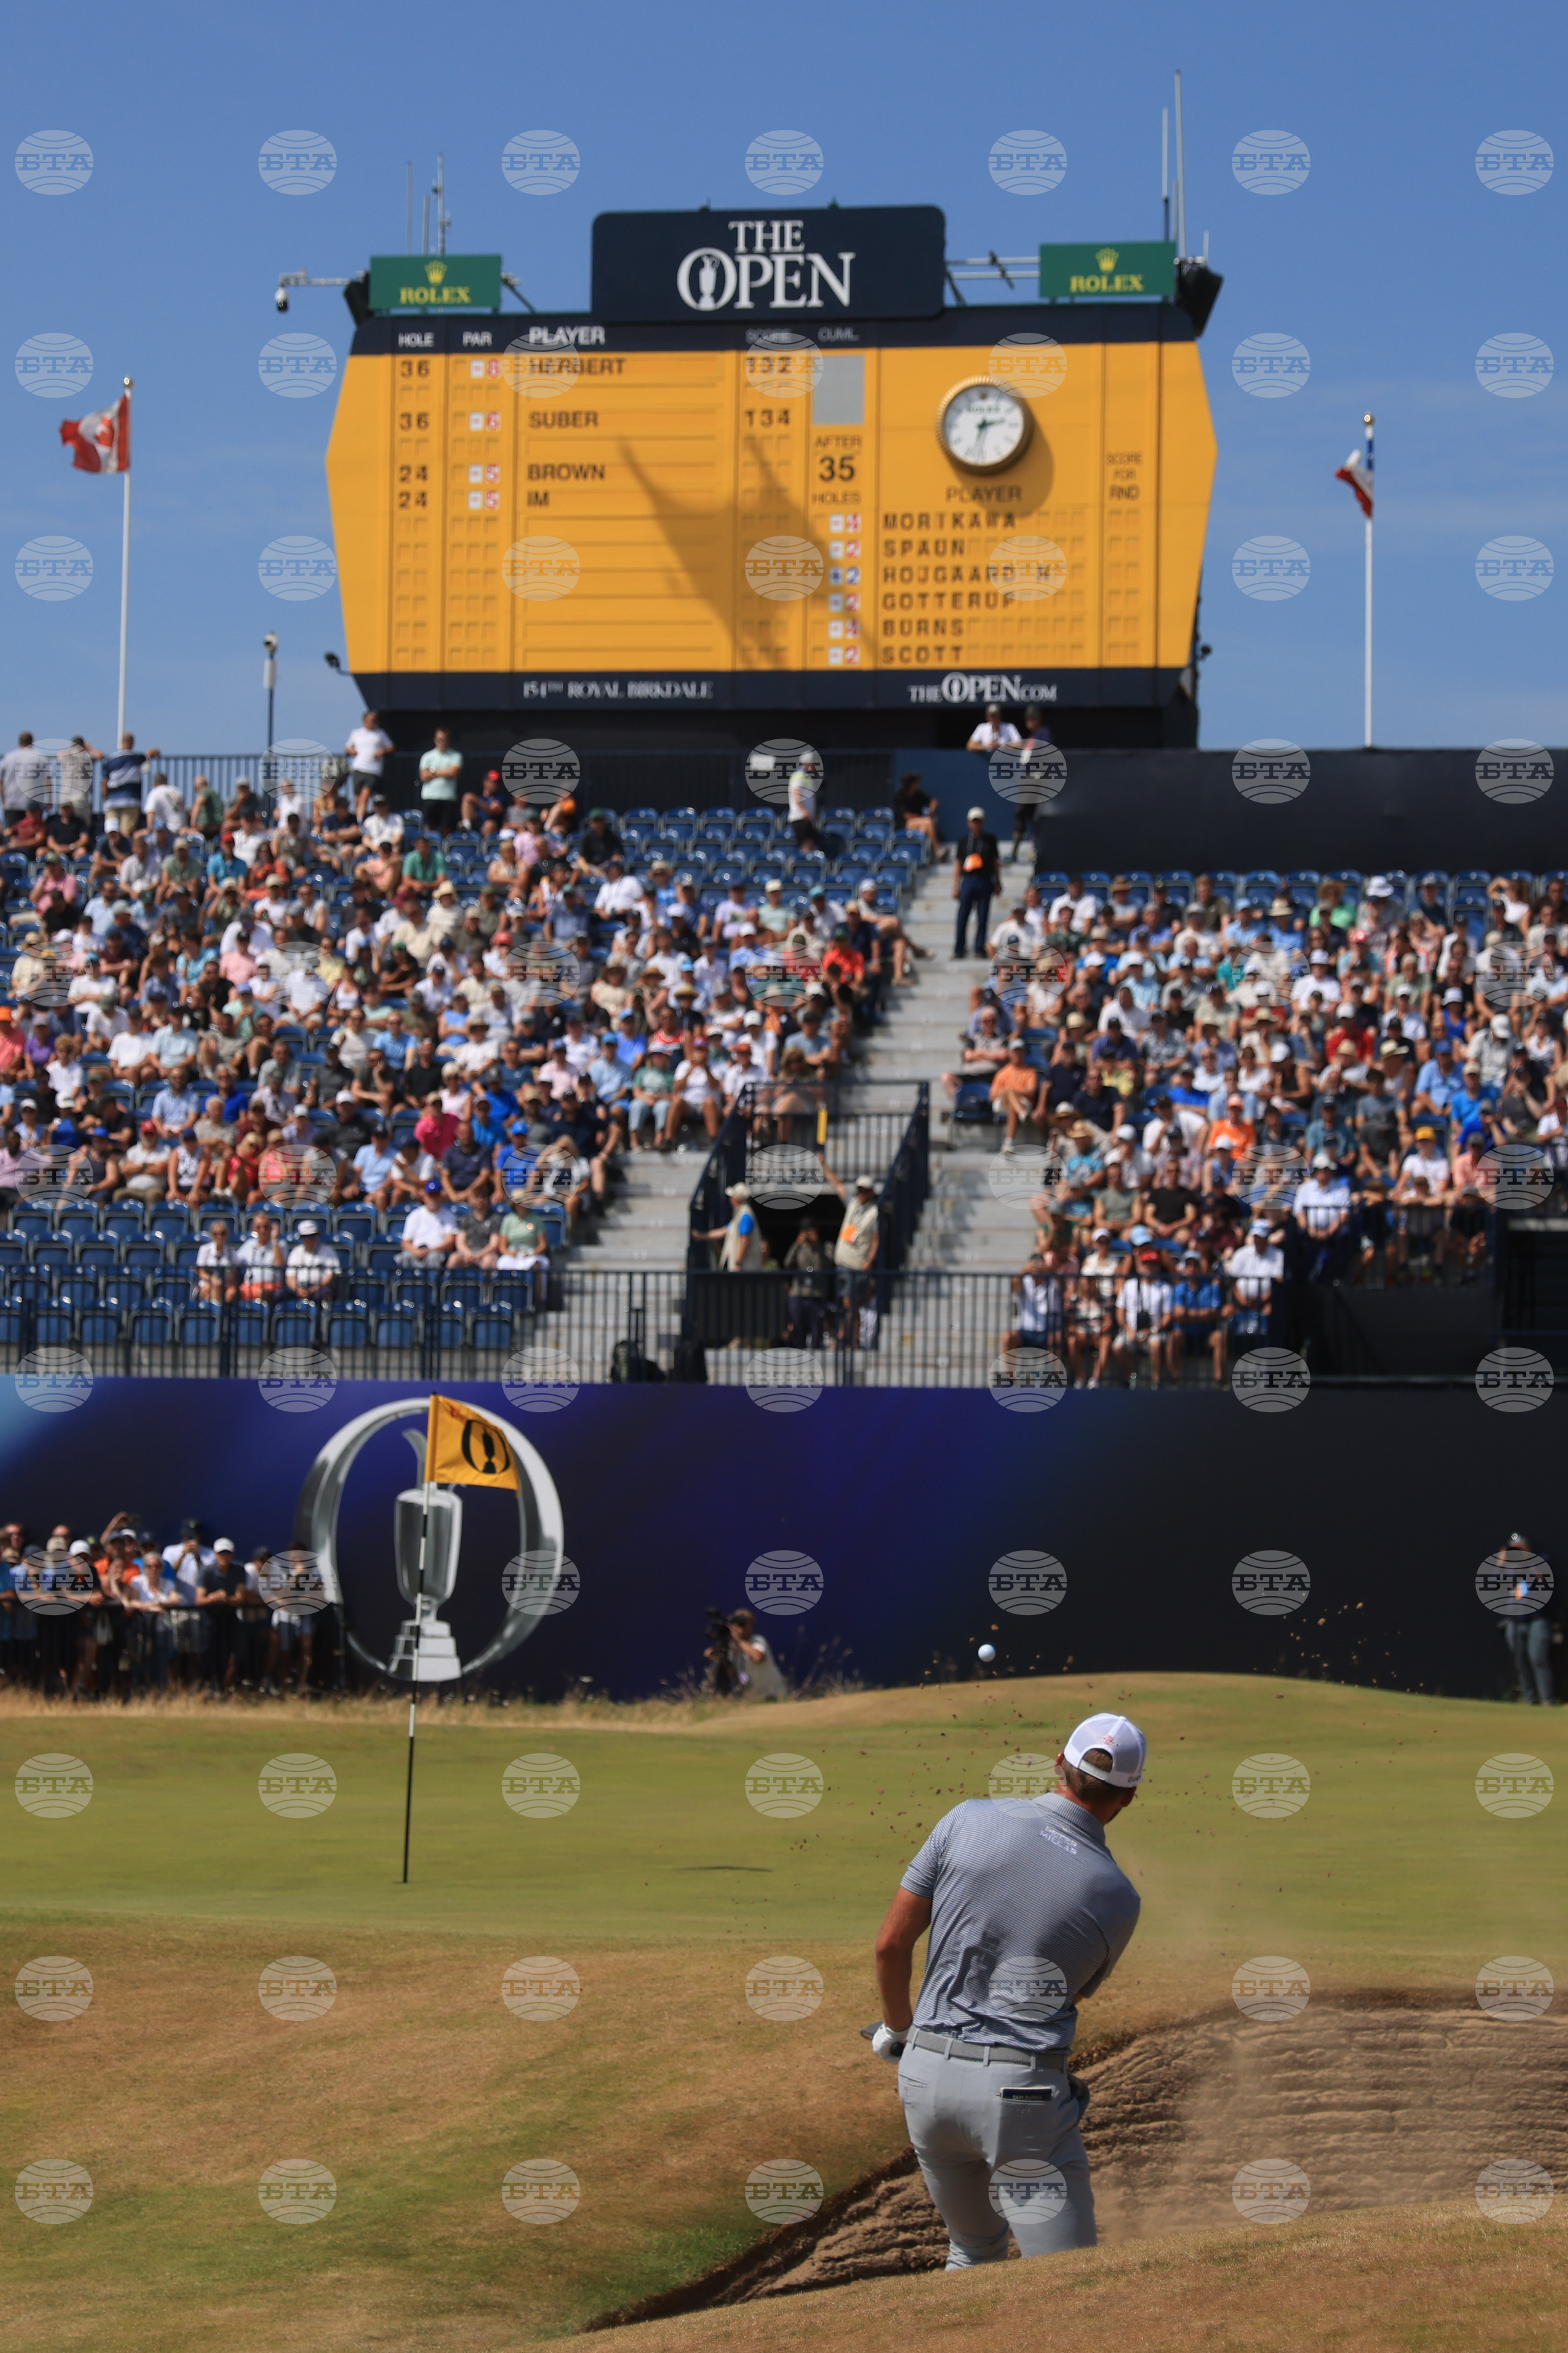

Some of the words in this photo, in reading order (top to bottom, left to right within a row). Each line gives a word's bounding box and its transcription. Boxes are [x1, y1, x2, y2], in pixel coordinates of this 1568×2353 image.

[728, 220, 805, 253] THE
[677, 247, 856, 312] OPEN
[1070, 275, 1144, 293] ROLEX
[400, 287, 471, 304] ROLEX
[398, 332, 435, 348] HOLE
[462, 331, 492, 347] PAR
[529, 326, 605, 346] PLAYER
[400, 359, 430, 378] 36
[400, 411, 430, 431] 36
[529, 411, 599, 429] SUBER
[745, 409, 790, 427] 134
[814, 434, 862, 448] AFTER
[399, 464, 429, 483] 24
[527, 463, 606, 482] BROWN
[819, 455, 855, 482] 35
[398, 490, 428, 509] 24
[527, 490, 550, 507] IM
[811, 490, 862, 506] HOLES
[945, 485, 1022, 503] PLAYER
[884, 513, 1016, 531] MORIKAWA
[884, 539, 965, 558] SPAUN
[883, 592, 1015, 611] GOTTERUP
[883, 619, 965, 637] BURNS
[883, 645, 964, 664] SCOTT
[567, 680, 625, 699] ROYAL
